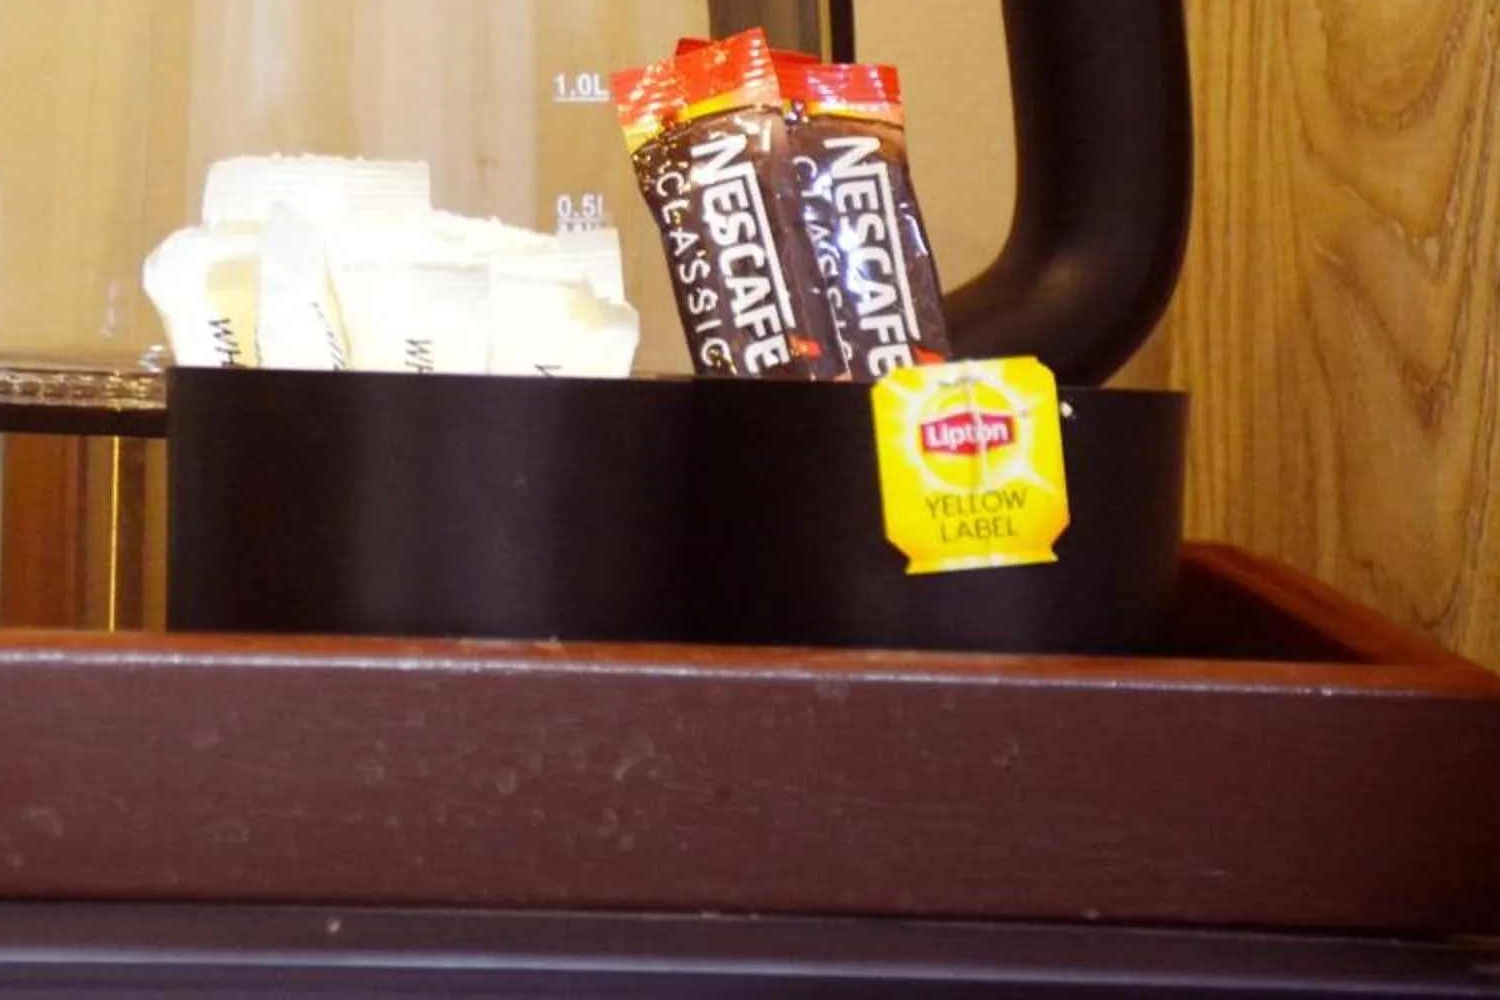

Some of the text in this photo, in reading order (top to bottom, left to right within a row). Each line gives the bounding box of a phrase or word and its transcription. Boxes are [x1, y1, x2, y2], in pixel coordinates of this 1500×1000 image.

[553, 72, 609, 97] 1.0L
[654, 170, 731, 369] CLASSIC
[925, 421, 1009, 451] Lipton
[923, 488, 1028, 519] YELLOW
[940, 515, 1019, 544] LABEL
